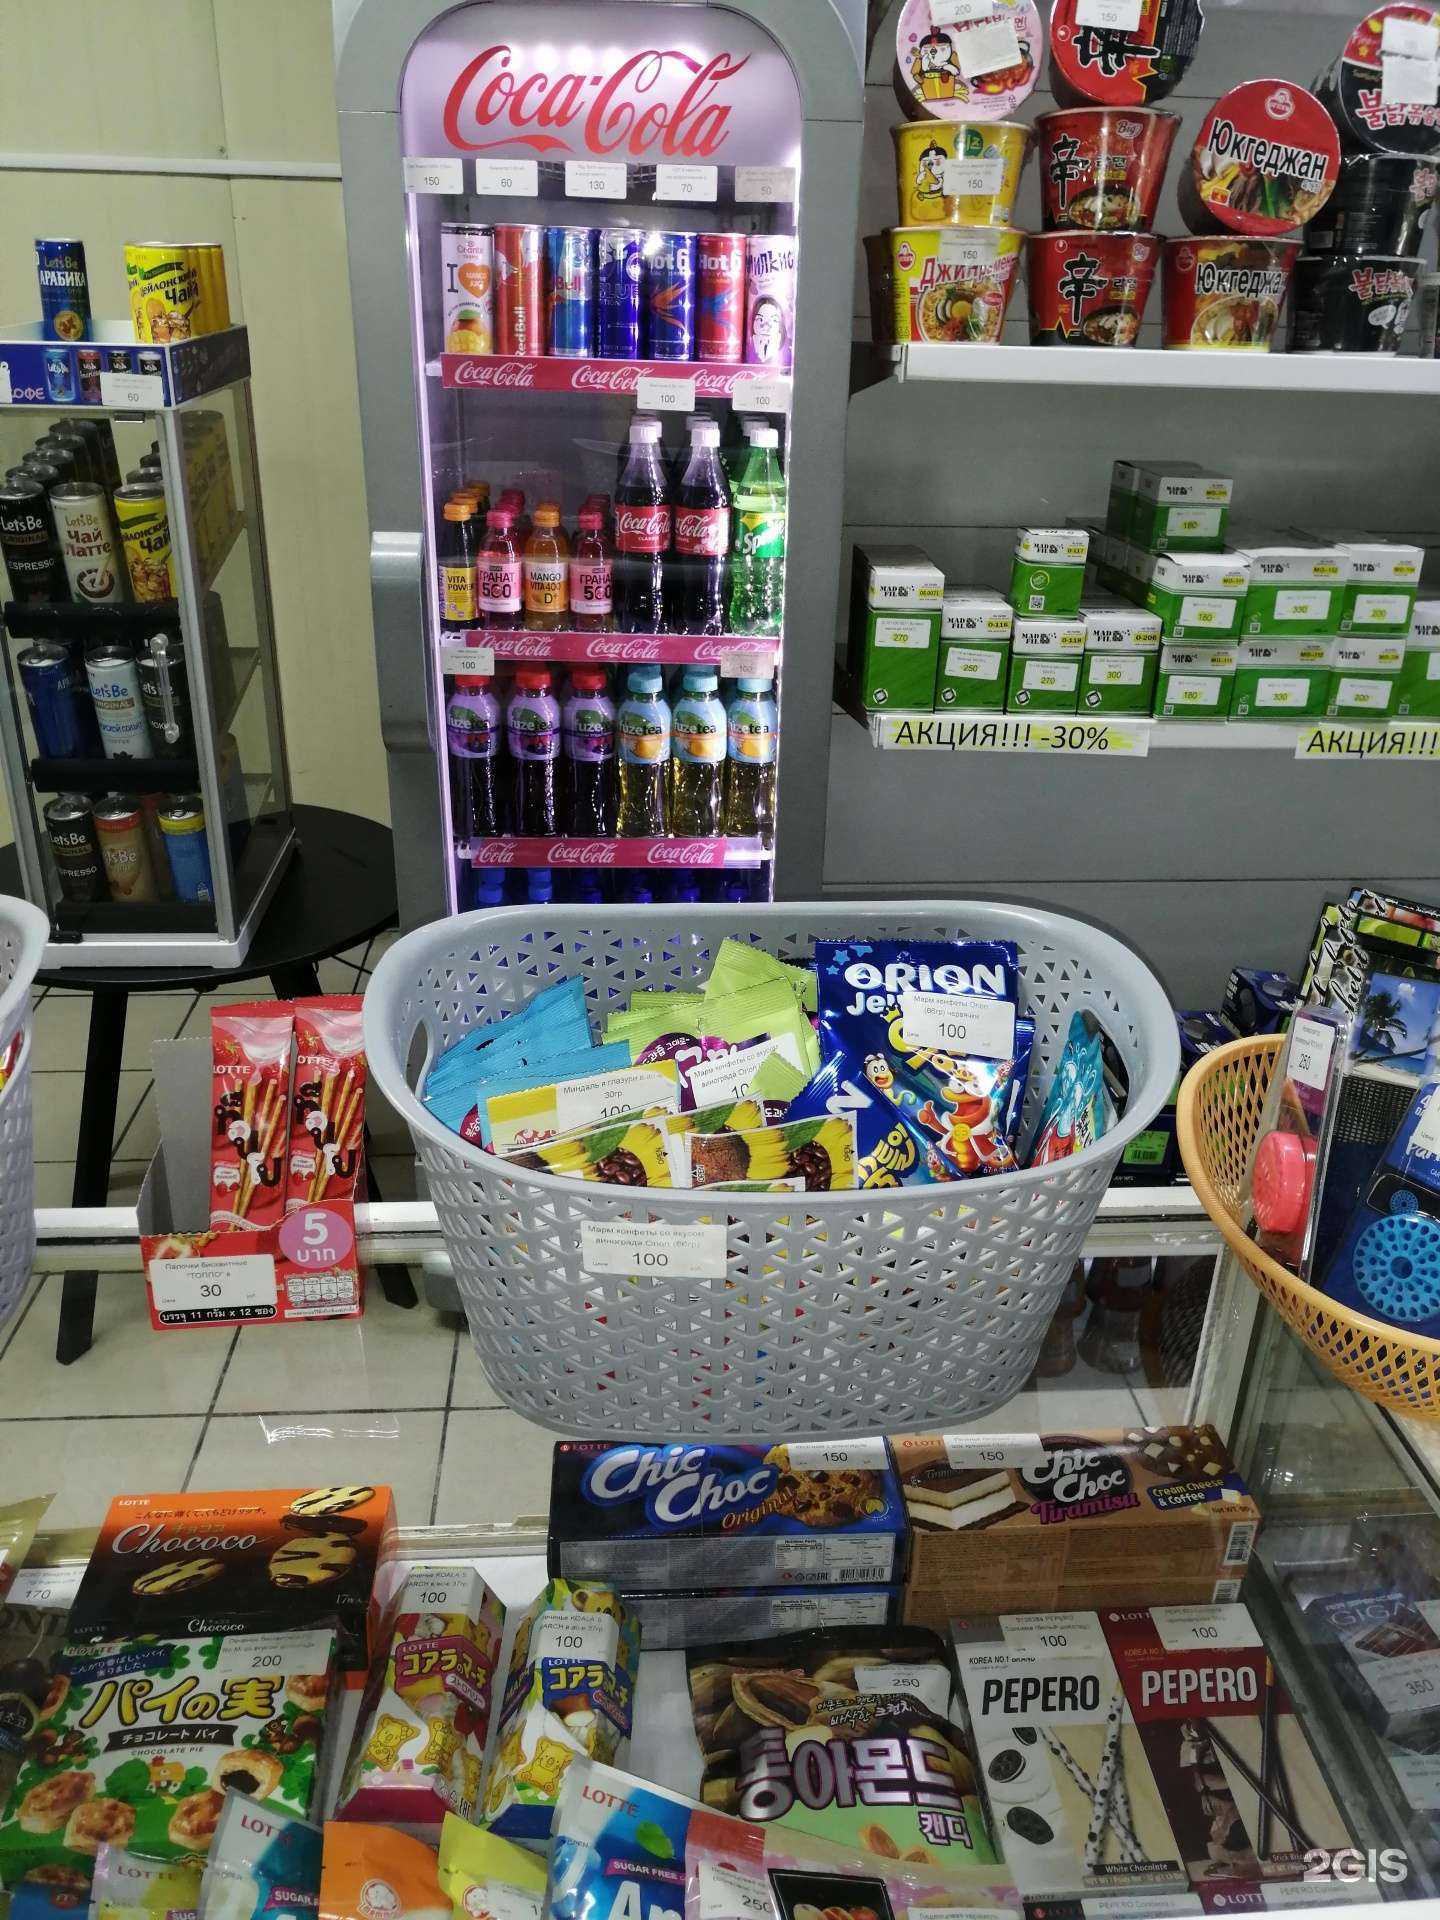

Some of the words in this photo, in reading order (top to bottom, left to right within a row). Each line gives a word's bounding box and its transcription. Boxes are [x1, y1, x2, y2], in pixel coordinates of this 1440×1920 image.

[955, 4, 972, 15] 200
[1101, 12, 1117, 22] 150
[444, 46, 752, 157] Coca-Cola
[1207, 118, 1329, 183] Юкгеджан
[1050, 132, 1090, 210] 辛
[424, 176, 440, 187] 150
[588, 180, 605, 191] 130
[680, 183, 693, 193] 70
[968, 179, 983, 189] 150
[963, 249, 978, 259] 150
[40, 270, 85, 287] АРАБИКА
[166, 282, 199, 306] Чай
[1058, 251, 1108, 326] 辛
[454, 363, 538, 388] Coca-Cola
[660, 394, 675, 404] 100
[755, 396, 770, 406] 100
[67, 527, 102, 544] Чай
[65, 543, 112, 558] Латте
[9, 558, 55, 571] ESPRESSO
[447, 575, 466, 584] VITA
[480, 571, 515, 583] ГРАНАТ
[530, 572, 561, 582] MANGO
[893, 634, 909, 642] 270
[1021, 632, 1040, 640] MAD
[1093, 629, 1112, 637] MAD
[585, 636, 663, 660] Coca-Cola
[461, 661, 476, 670] 100
[739, 664, 754, 673] 100
[962, 664, 979, 672] 250
[1040, 676, 1055, 685] 270
[1106, 671, 1122, 679] 300
[895, 720, 1031, 751] АКЦИЯ!!!
[1040, 724, 1110, 751] -30%
[547, 843, 618, 865] Coca-Cola
[647, 841, 717, 864] Coca-Cola
[844, 961, 1006, 996] ORION
[938, 1022, 967, 1039] 100
[211, 1064, 251, 1076] LOTTE
[562, 1082, 600, 1096] Миндаль
[606, 1074, 639, 1087] глазури
[604, 1089, 624, 1100] 30гр
[303, 1212, 329, 1245] 5
[587, 1225, 614, 1234] Марм
[616, 1228, 658, 1238] конфеты
[595, 1238, 644, 1247] винограда
[296, 1246, 337, 1264] บาท
[632, 1253, 668, 1267] 100
[199, 1284, 222, 1298] 30
[161, 1310, 188, 1325] บรรจุ
[190, 1310, 203, 1319] 11
[206, 1307, 226, 1318] กรัม
[239, 1307, 252, 1316] 12
[253, 1305, 275, 1316] ซอง
[822, 1451, 848, 1463] 150
[979, 1450, 1004, 1462] 150
[1022, 1447, 1102, 1484] Chic
[590, 1445, 706, 1501] Chic
[1052, 1467, 1127, 1504] Choc
[1152, 1483, 1186, 1498] Cream
[1186, 1477, 1225, 1493] Cheese
[119, 1498, 151, 1507] LOTTE
[654, 1469, 772, 1523] Choc
[1158, 1499, 1167, 1508] &
[1167, 1491, 1206, 1505] Coffee
[721, 1483, 795, 1530] Original
[1030, 1491, 1141, 1526] Tiramisu
[111, 1522, 280, 1556] Chococo
[25, 1589, 51, 1600] 170
[418, 1591, 447, 1604] 100
[187, 1617, 245, 1634] Chococo
[1192, 1626, 1219, 1640] 100
[402, 1641, 439, 1652] LOTTE
[555, 1635, 584, 1648] 100
[1040, 1634, 1067, 1648] 100
[251, 1655, 282, 1669] 200
[968, 1655, 993, 1665] KOREA
[891, 1678, 921, 1689] 250
[1141, 1666, 1259, 1707] PEPERO
[1405, 1679, 1434, 1697] 350
[78, 1675, 286, 1730] パイの実
[981, 1675, 1100, 1716] PEPERO
[121, 1728, 190, 1745] チョコレート
[195, 1726, 221, 1739] パイ
[130, 1746, 187, 1758] CHOCOLATE
[188, 1745, 205, 1754] PIE
[735, 1726, 966, 1823] 통아몬드
[582, 1783, 640, 1819] LOTTE
[918, 1810, 974, 1850] 캔디
[613, 1859, 651, 1875] SUGAR
[651, 1867, 678, 1881] FREE
[1104, 1862, 1127, 1874] White
[1127, 1861, 1169, 1873] Chocolate
[741, 1893, 773, 1913] 250
